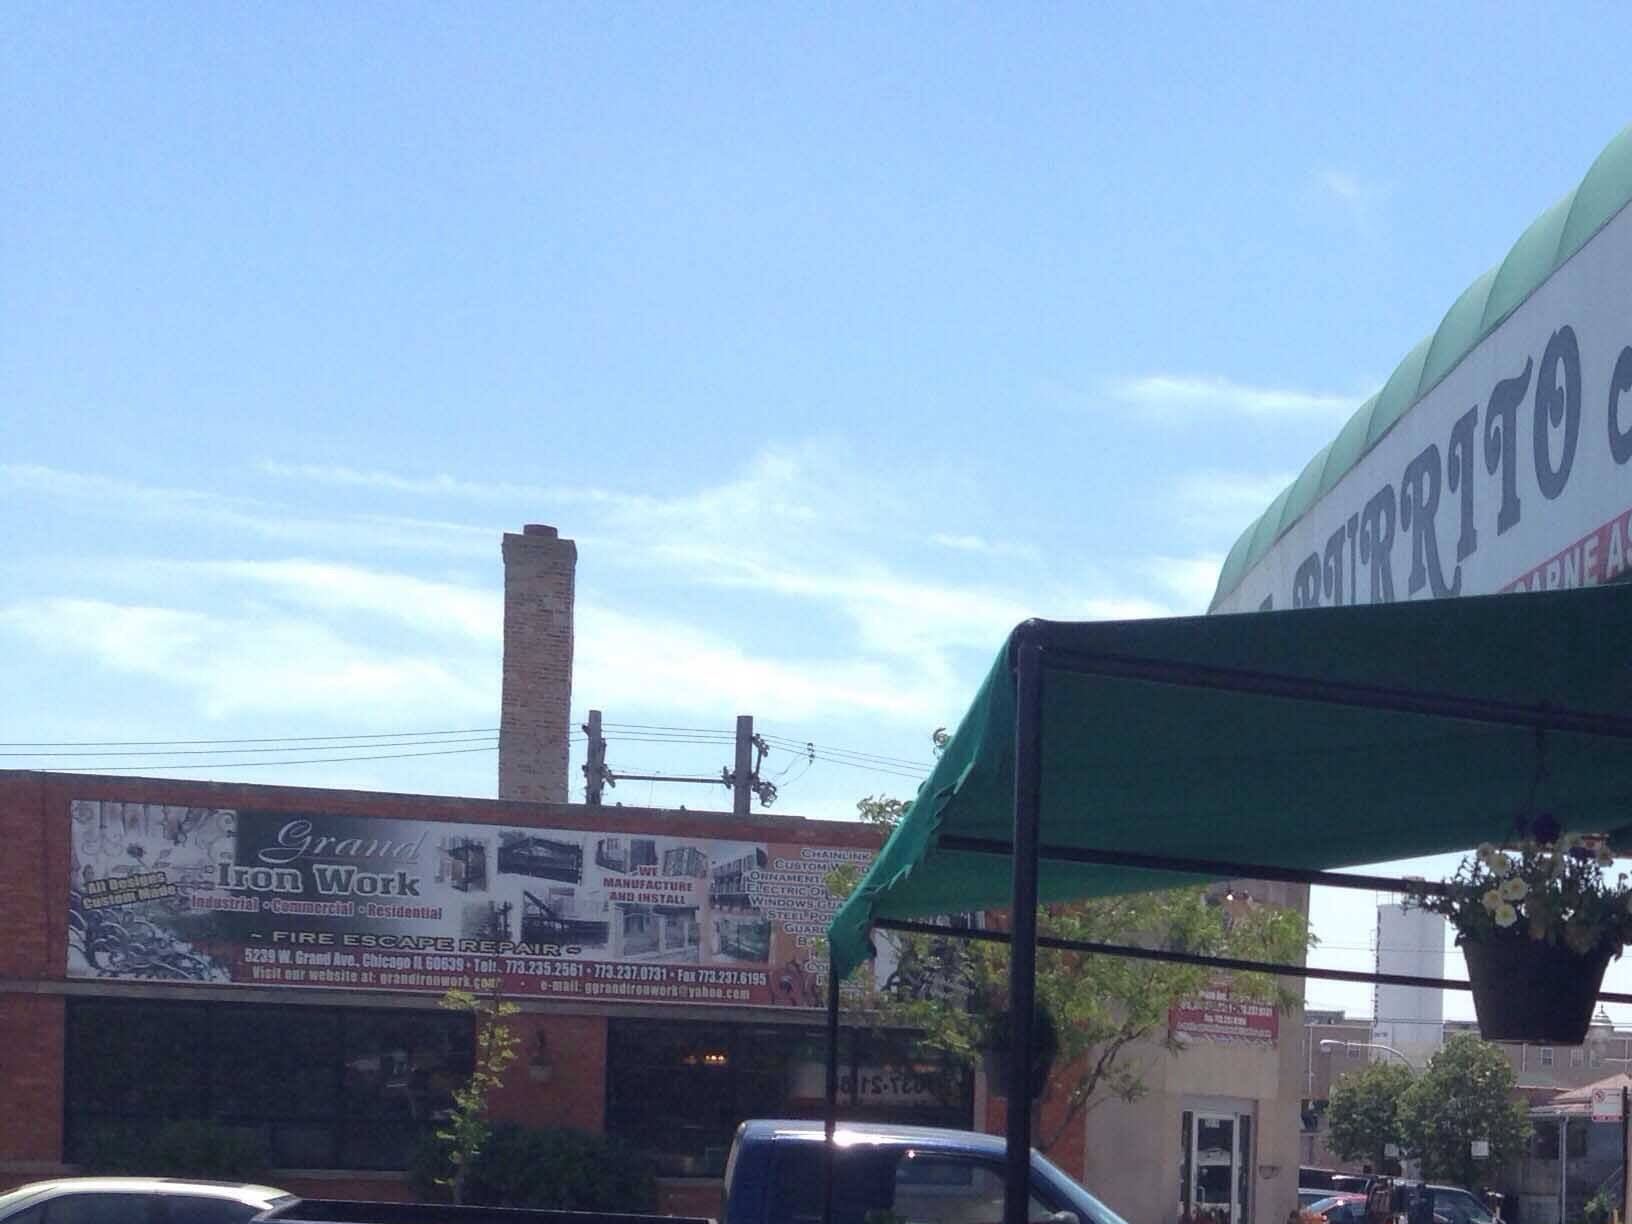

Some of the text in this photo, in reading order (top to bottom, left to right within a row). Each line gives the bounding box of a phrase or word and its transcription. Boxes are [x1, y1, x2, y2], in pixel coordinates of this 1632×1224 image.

[259, 819, 428, 865] Grand
[216, 861, 422, 898] Iron Work
[638, 866, 658, 877] WE
[603, 877, 694, 893] MANUFACTURE
[191, 895, 443, 920] Industrial Commercial Residential
[608, 891, 688, 906] AND INSTALL
[272, 930, 561, 957] FIRE ESCAPE REPAIR
[244, 948, 276, 964] 5239
[295, 950, 332, 966] Grand
[362, 952, 411, 970] Chicago
[425, 955, 464, 972] 60639
[505, 959, 584, 977] 773.235.2561
[593, 964, 667, 982] 773.237.0731
[677, 967, 697, 984] Fax
[698, 968, 767, 986] 773.237.6195
[252, 965, 281, 980] Visit
[284, 968, 306, 981] our
[309, 968, 358, 983] website
